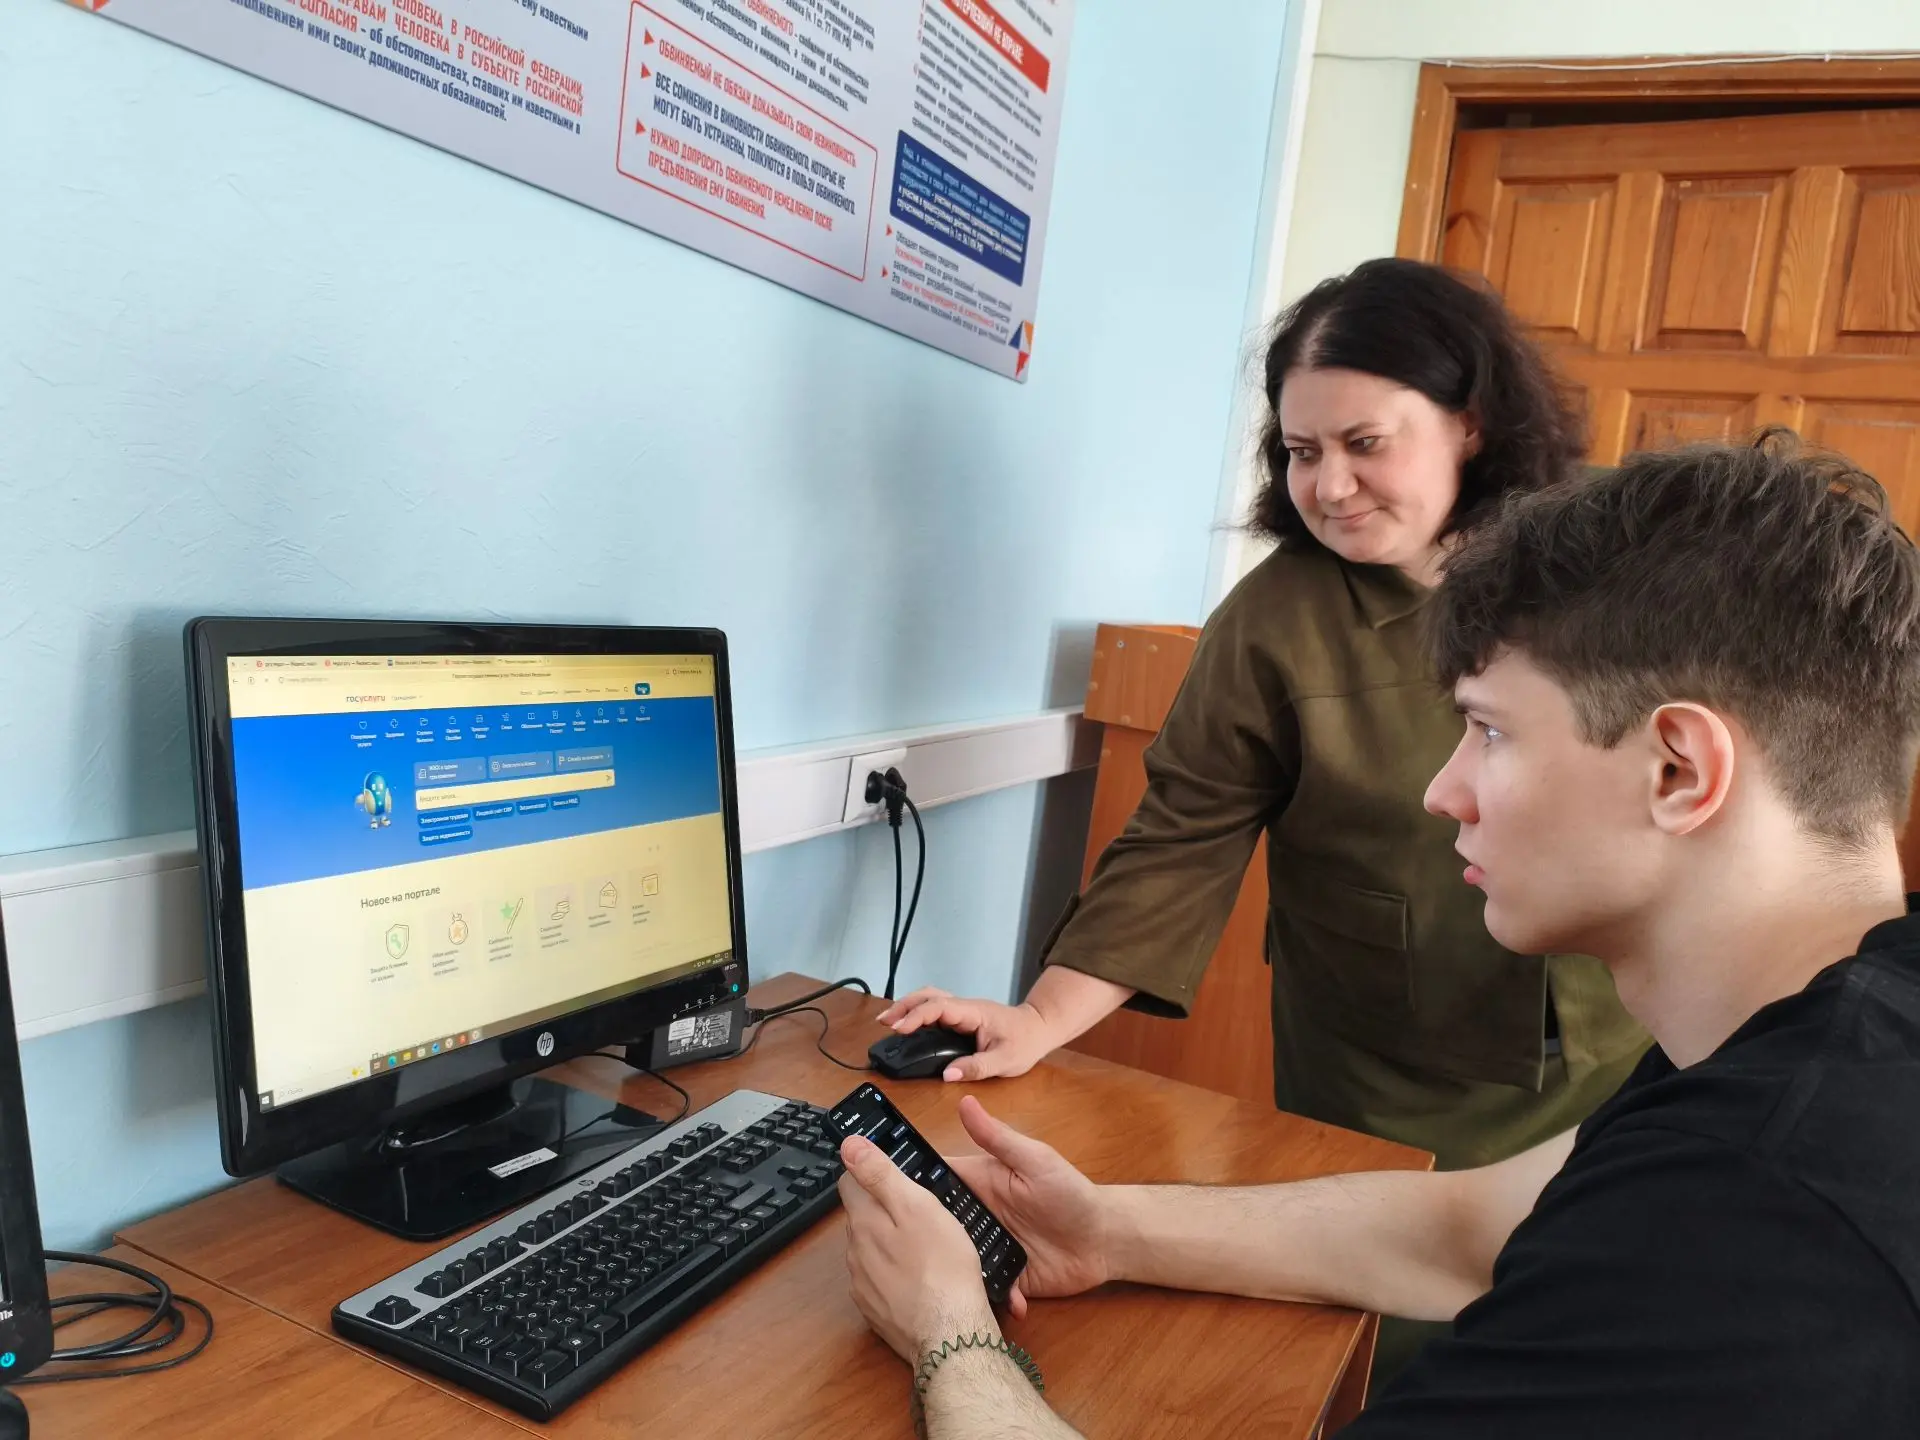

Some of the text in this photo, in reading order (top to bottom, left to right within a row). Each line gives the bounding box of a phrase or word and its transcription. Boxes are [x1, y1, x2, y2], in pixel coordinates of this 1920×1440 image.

[451, 19, 458, 35] В
[465, 26, 525, 69] РОССИЙСКОЙ
[540, 6, 588, 41] известными
[308, 22, 330, 43] ими
[333, 34, 367, 60] своих
[368, 50, 439, 92] должностных
[442, 82, 507, 122] обязанностей.
[370, 28, 383, 44] об
[386, 35, 470, 86] обстоятельствах,
[472, 74, 509, 102] ставших
[512, 93, 523, 108] им
[525, 100, 574, 132] известными
[395, 12, 450, 54] ЧЕЛОВЕКА
[457, 44, 465, 60] В
[471, 50, 520, 87] СУБЪЕКТЕ
[525, 76, 583, 117] РОССИЙСКОЙ
[659, 39, 712, 82] ОБВИНЯЕМЫЙ
[713, 70, 724, 89] НЕ
[724, 77, 751, 105] ОБЯЗАН
[752, 94, 794, 131] ДОКАЗЫВАТЬ
[654, 95, 679, 121] МОГУТ
[681, 110, 702, 133] БЫТЬ
[704, 121, 745, 159] УСТРАНЕНЫ,
[747, 144, 785, 177] ТОЛКУЮТСЯ
[786, 163, 791, 181] В
[792, 166, 815, 192] ПОЛЬЗУ
[656, 71, 670, 93] ВСЕ
[672, 83, 712, 116] СОМНЕНИЯ
[714, 103, 719, 120] В
[720, 106, 764, 146] ВИНОВНОСТИ
[649, 150, 708, 191] ПРЕДЪЯВЛЕНИЯ
[709, 180, 724, 201] ЕМУ
[651, 127, 680, 155] НУЖНО
[681, 141, 724, 177] ДОПРОСИТЬ
[725, 164, 773, 201] ОБВИНЯЕМОГО
[361, 886, 441, 908] Новое на портале
